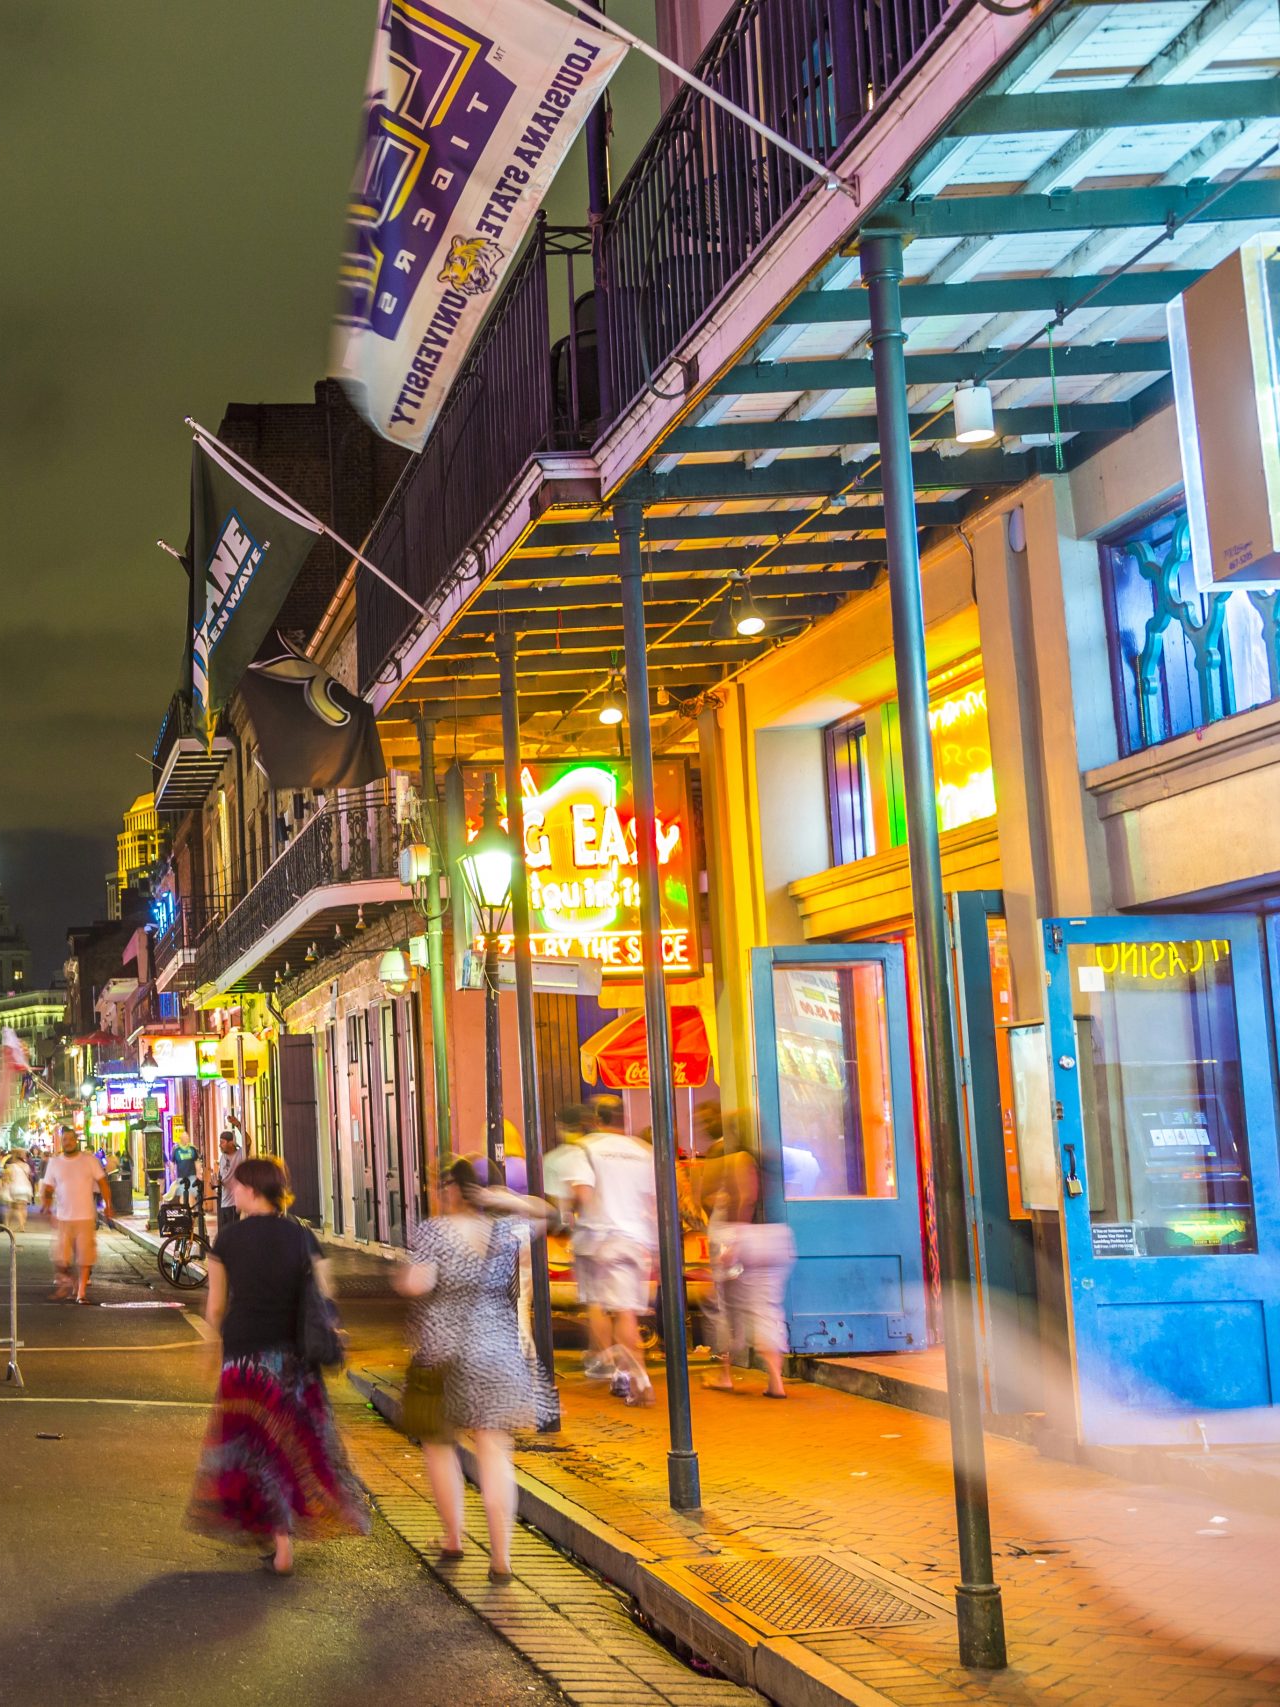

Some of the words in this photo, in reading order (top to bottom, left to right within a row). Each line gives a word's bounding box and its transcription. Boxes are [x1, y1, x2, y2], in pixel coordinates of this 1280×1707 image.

[226, 546, 262, 609] WAVE
[580, 938, 622, 964] THE
[626, 936, 688, 964] SCE
